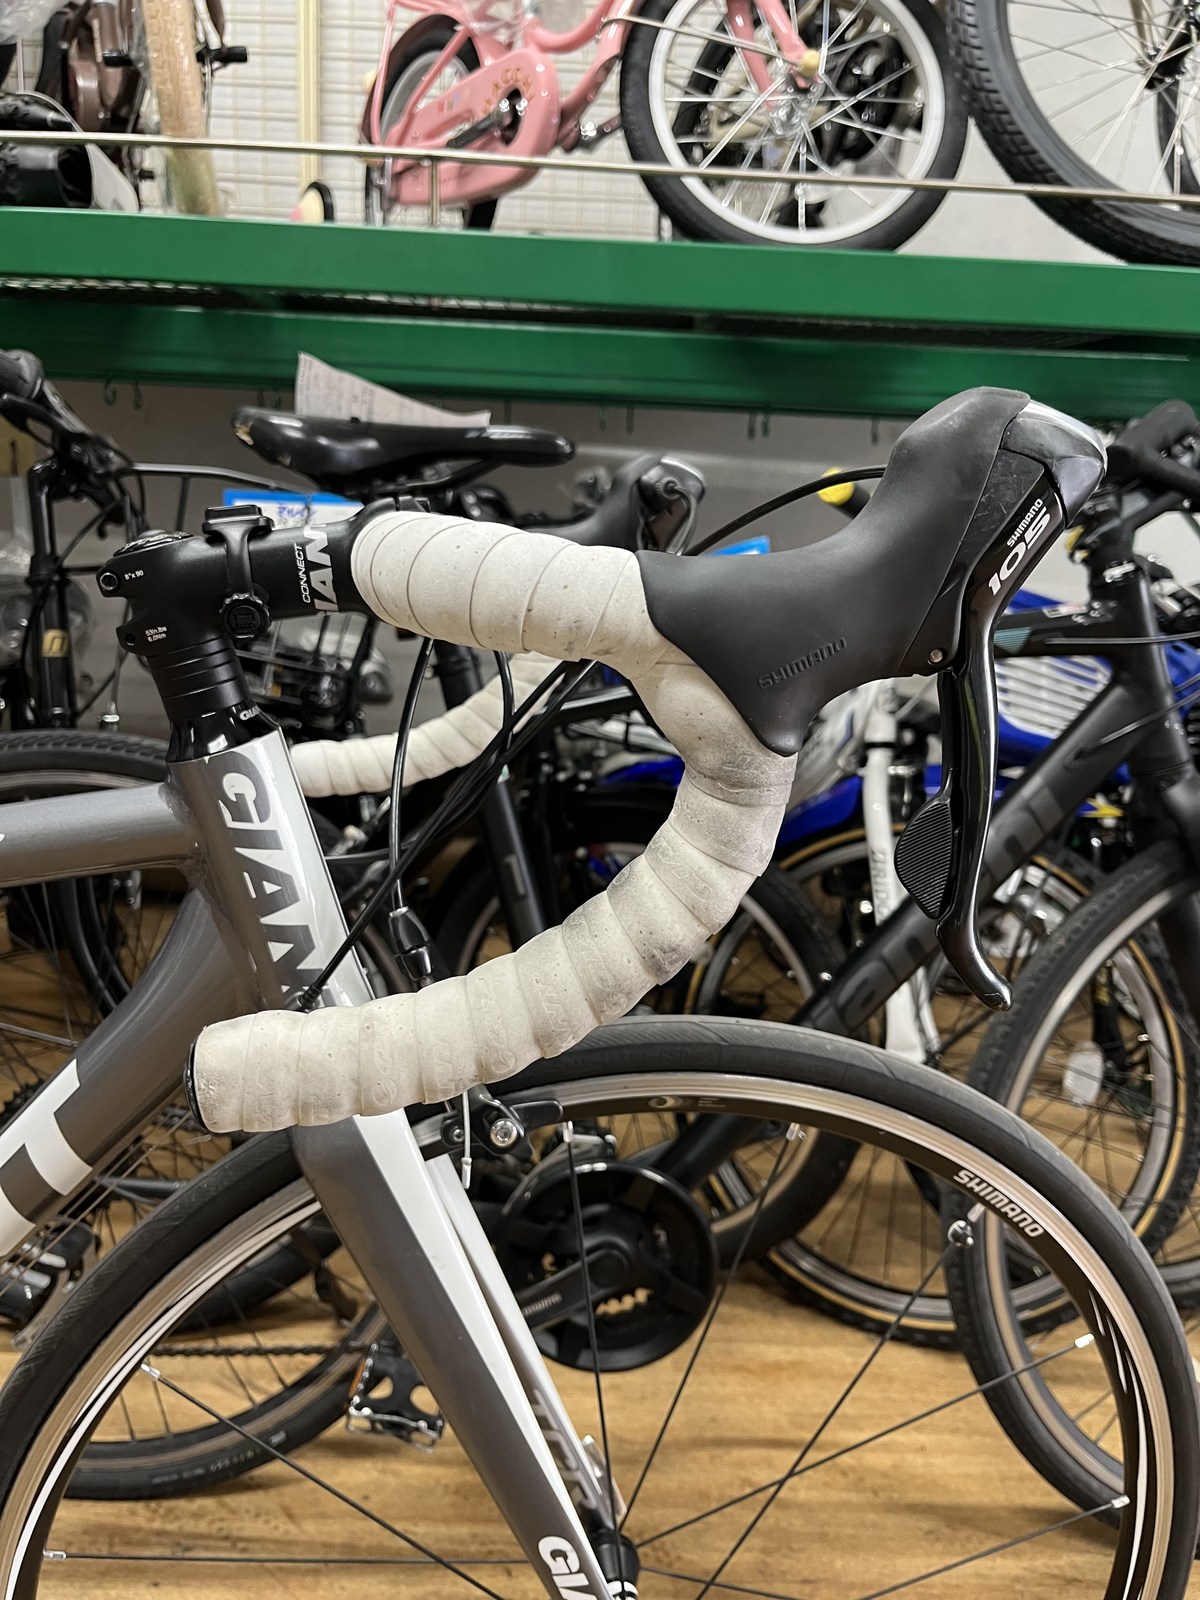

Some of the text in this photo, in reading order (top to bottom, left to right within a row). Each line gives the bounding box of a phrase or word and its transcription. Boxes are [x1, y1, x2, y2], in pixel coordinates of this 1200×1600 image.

[988, 506, 1051, 596] 105
[1006, 498, 1044, 548] SHIMANO
[294, 542, 312, 604] CONNECT
[303, 524, 339, 612] IAN
[758, 636, 847, 689] SHIMANO
[953, 1169, 1044, 1237] SHIMANO
